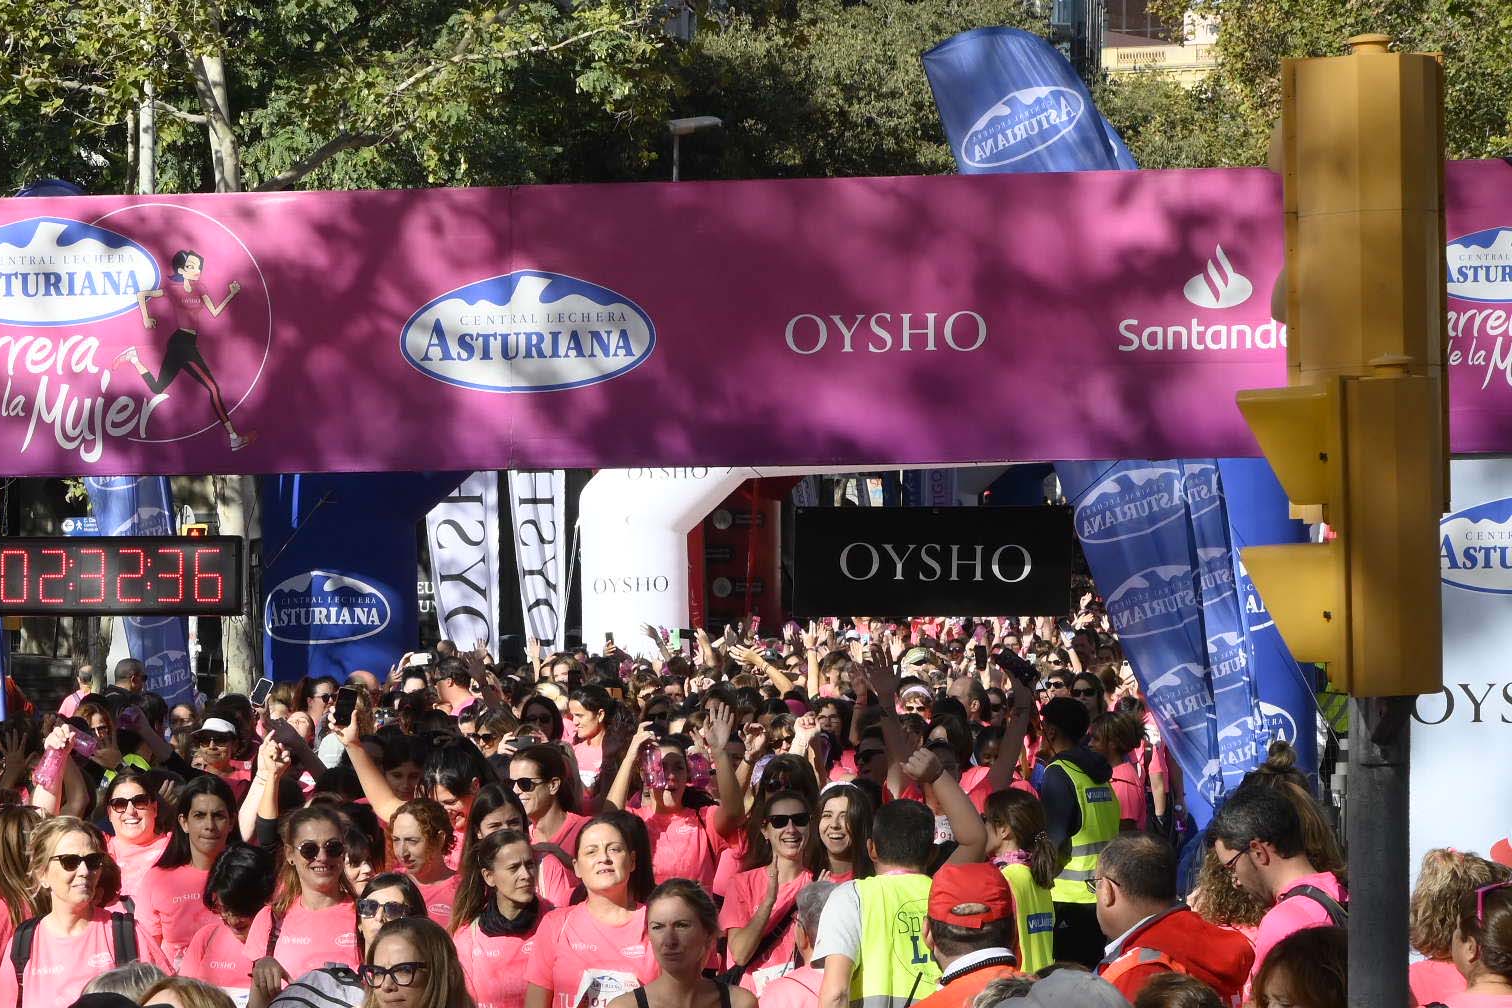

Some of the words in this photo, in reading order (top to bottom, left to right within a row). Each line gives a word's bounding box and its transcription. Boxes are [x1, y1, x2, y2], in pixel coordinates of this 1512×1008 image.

[63, 252, 136, 266] LECHERA
[459, 312, 536, 326] CENTRAL
[546, 310, 628, 324] LECHERA
[784, 310, 987, 355] OYSHO
[421, 318, 635, 362] ASTURIANA
[2, 378, 26, 418] la
[21, 368, 170, 463] Mujer
[840, 542, 1033, 584] OYSHO
[592, 575, 669, 595] OYSHO
[267, 600, 381, 627] ASTURIANA
